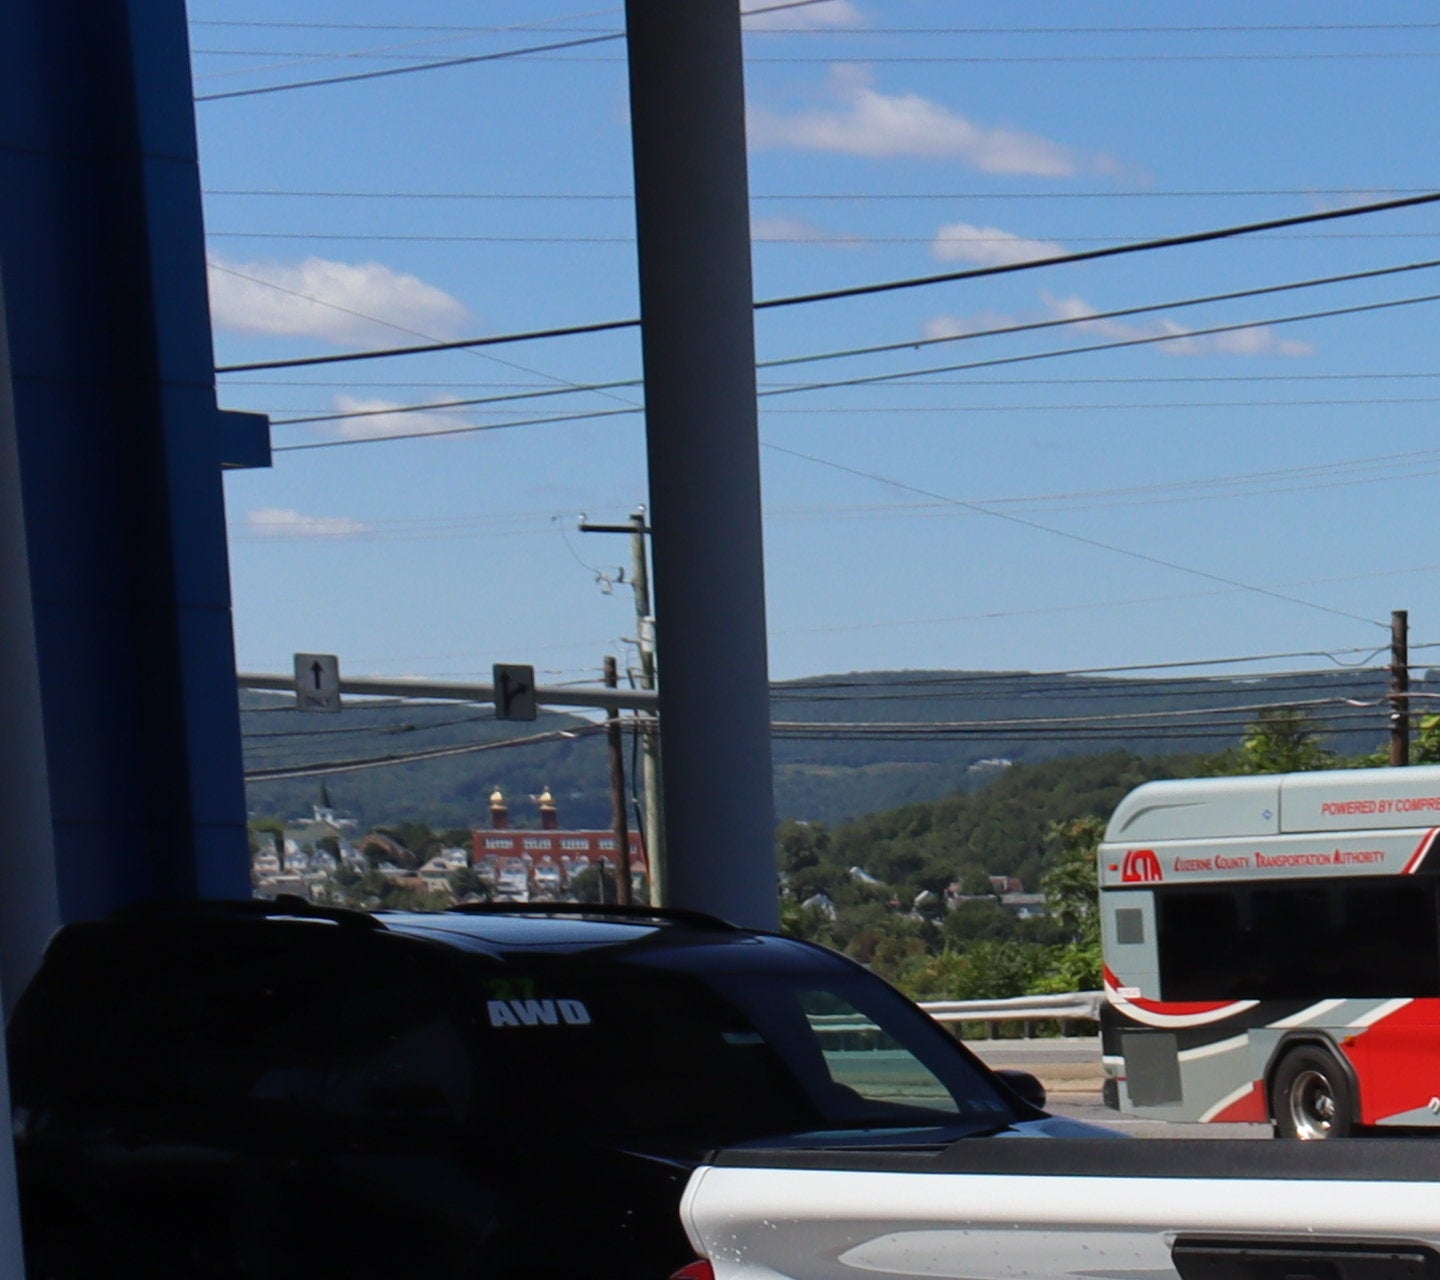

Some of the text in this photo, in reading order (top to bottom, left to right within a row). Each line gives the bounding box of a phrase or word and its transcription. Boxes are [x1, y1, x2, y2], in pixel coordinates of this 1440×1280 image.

[1321, 801, 1376, 815] POWERED
[1378, 800, 1395, 814] BY
[1173, 849, 1386, 872] LUZERNE COUNTY TRANSPORTATION AUTHORITY
[487, 1000, 591, 1027] AWD
